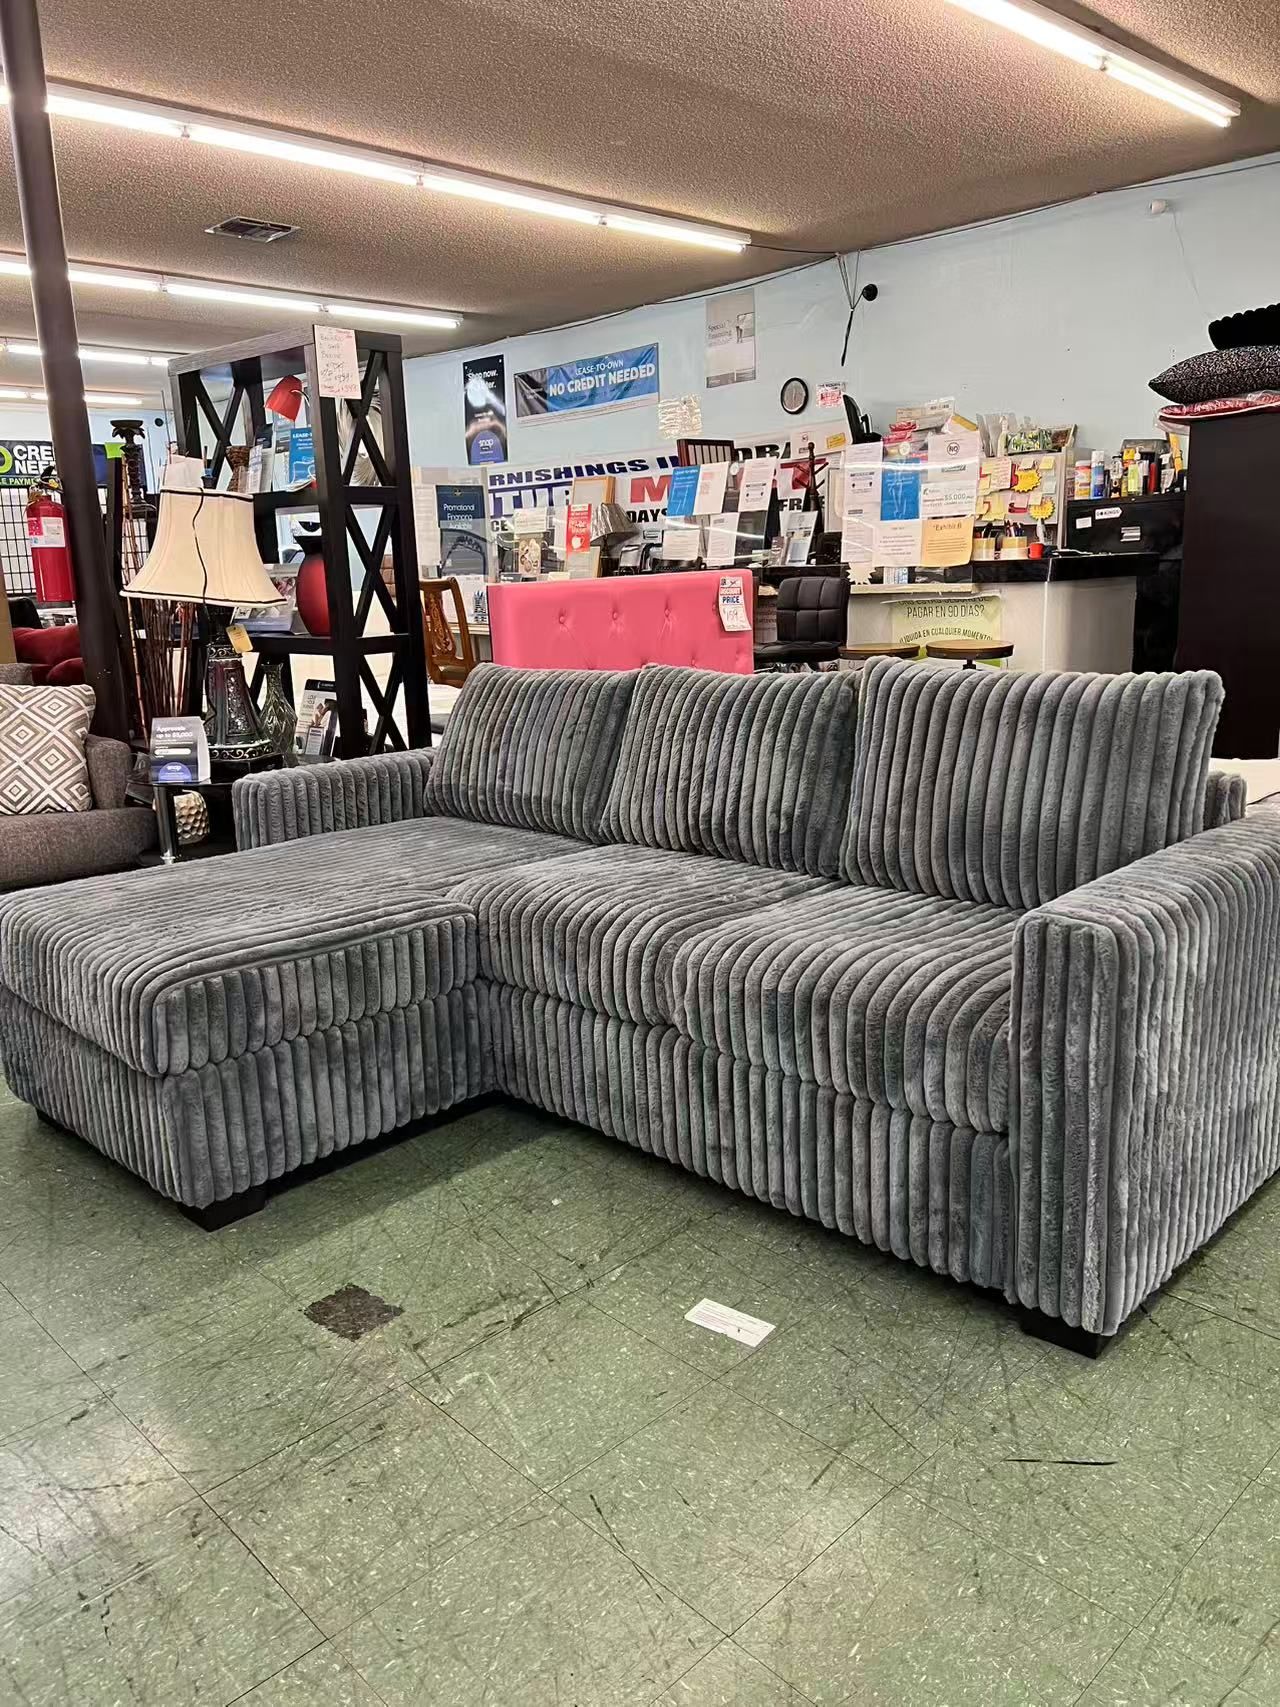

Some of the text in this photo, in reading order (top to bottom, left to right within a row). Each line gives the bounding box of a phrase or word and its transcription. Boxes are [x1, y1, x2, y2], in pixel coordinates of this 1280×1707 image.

[483, 370, 498, 379] now.
[549, 383, 565, 396] NO
[567, 374, 607, 392] CREDIT
[608, 363, 656, 385] NEEDED
[479, 439, 494, 448] snap
[443, 503, 475, 511] Promotional
[447, 513, 473, 522] Financing
[907, 606, 933, 618] PAGAR
[936, 605, 946, 618] EN
[948, 605, 959, 618] 90
[931, 627, 961, 636] CUALQUIER
